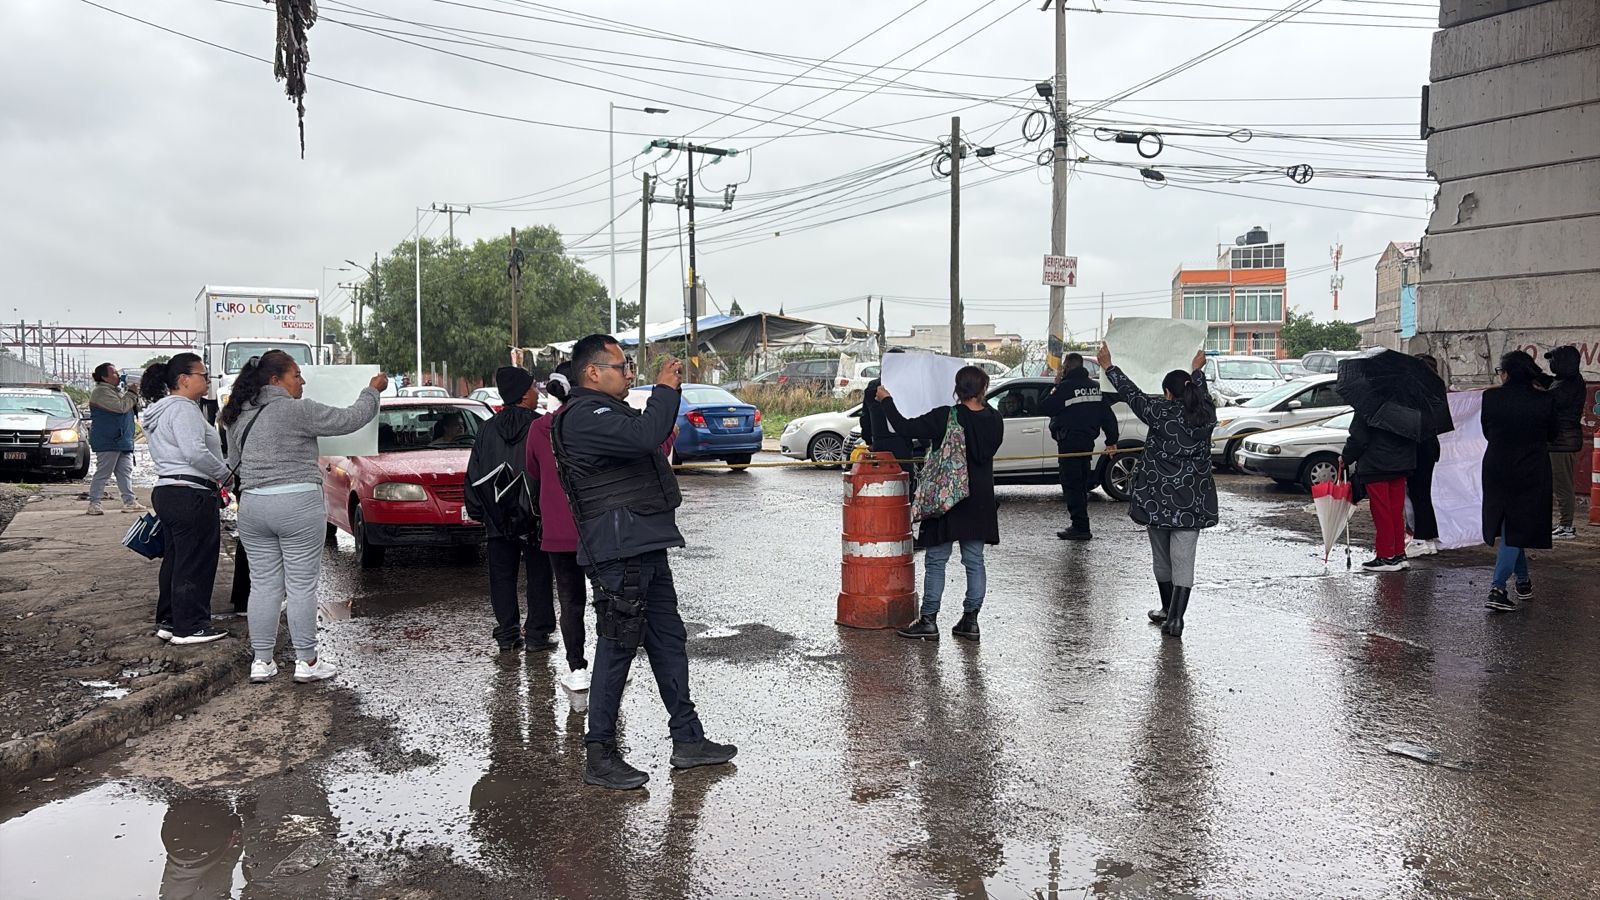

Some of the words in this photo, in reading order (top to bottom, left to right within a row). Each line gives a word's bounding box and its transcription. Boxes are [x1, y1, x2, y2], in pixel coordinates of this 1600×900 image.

[1044, 257, 1077, 269] VERIFICACION
[1044, 271, 1066, 283] FEDERAL
[216, 302, 246, 314] EURO
[249, 303, 297, 315] LOGISTIC
[282, 321, 314, 329] LIVORNO
